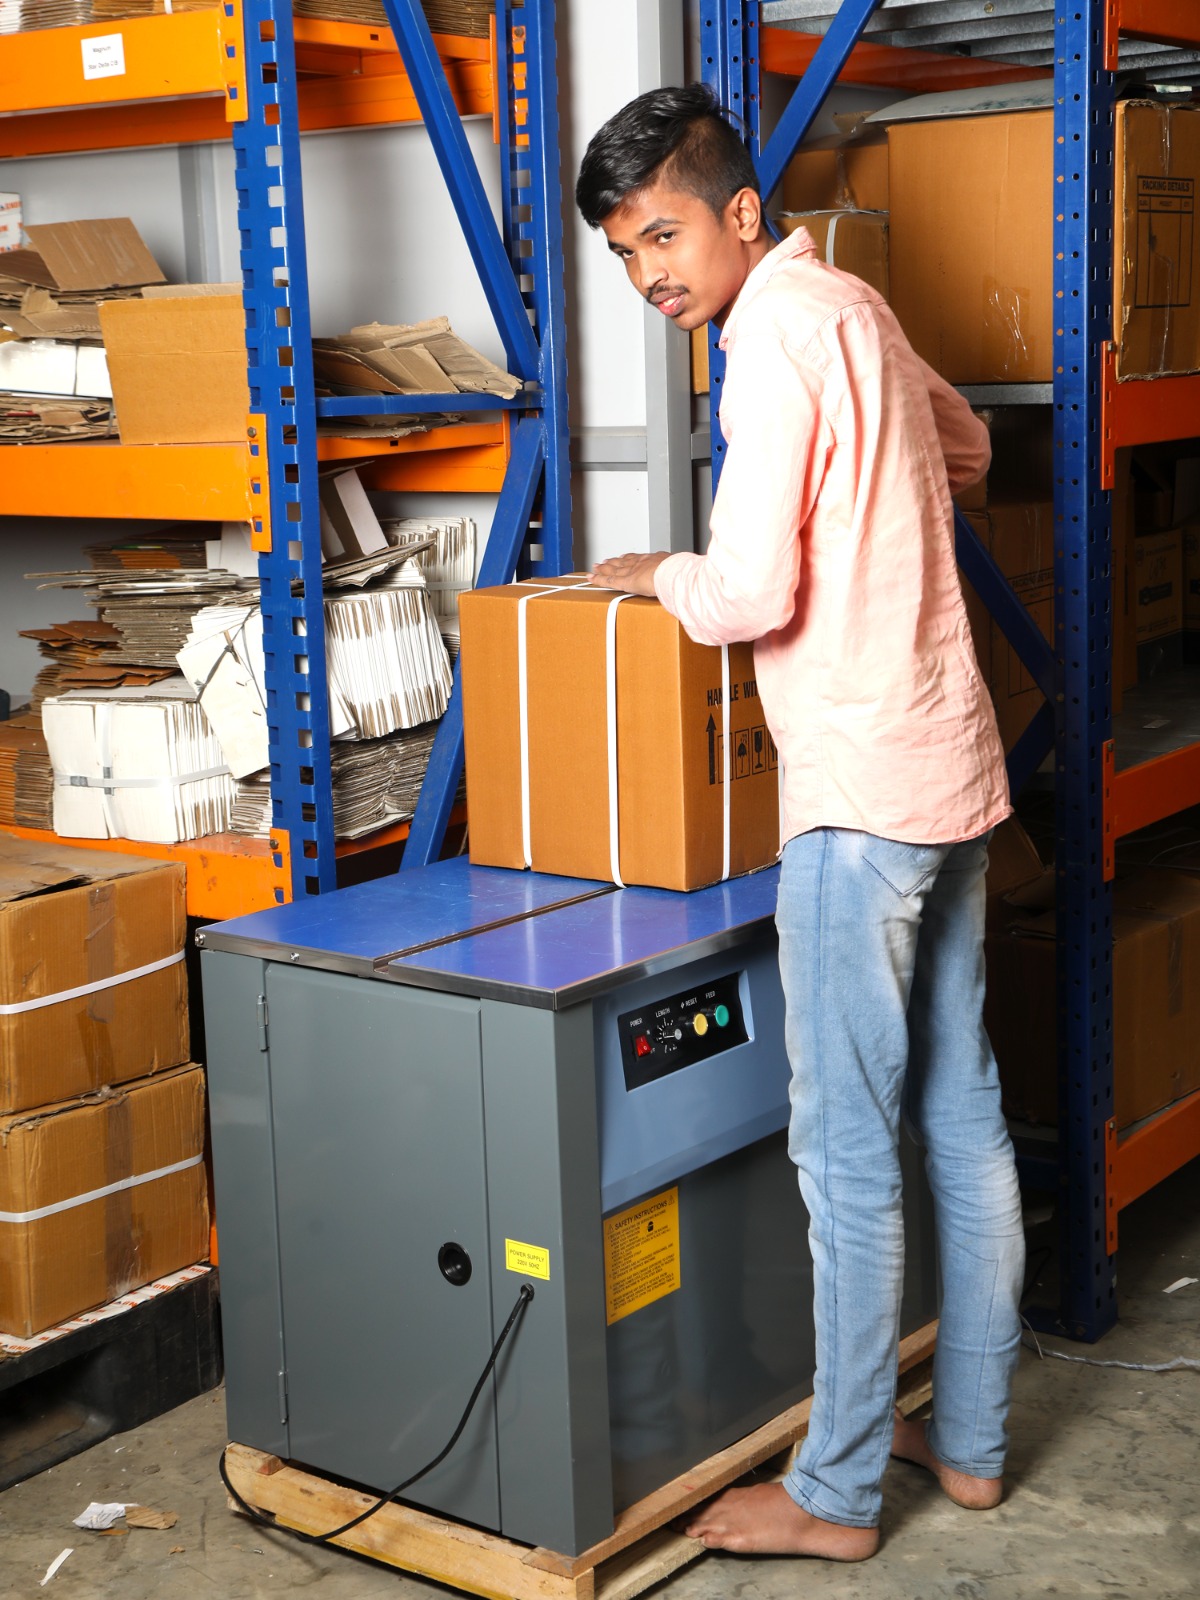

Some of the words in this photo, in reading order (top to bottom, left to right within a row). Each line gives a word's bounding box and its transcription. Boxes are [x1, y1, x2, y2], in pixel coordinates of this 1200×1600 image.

[1142, 180, 1167, 191] PACKING
[1167, 181, 1190, 192] DETAILS
[706, 684, 740, 707] HANLE
[742, 680, 759, 698] WIT
[705, 990, 716, 999] FEED
[684, 997, 698, 1007] RESET
[655, 1007, 671, 1018] LENGTH
[630, 1017, 643, 1028] POWER
[615, 1217, 633, 1230] SAFETY
[633, 1201, 667, 1220] INSTRUCTIONS
[509, 1249, 526, 1259] POWER
[527, 1253, 545, 1262] SUPPLY
